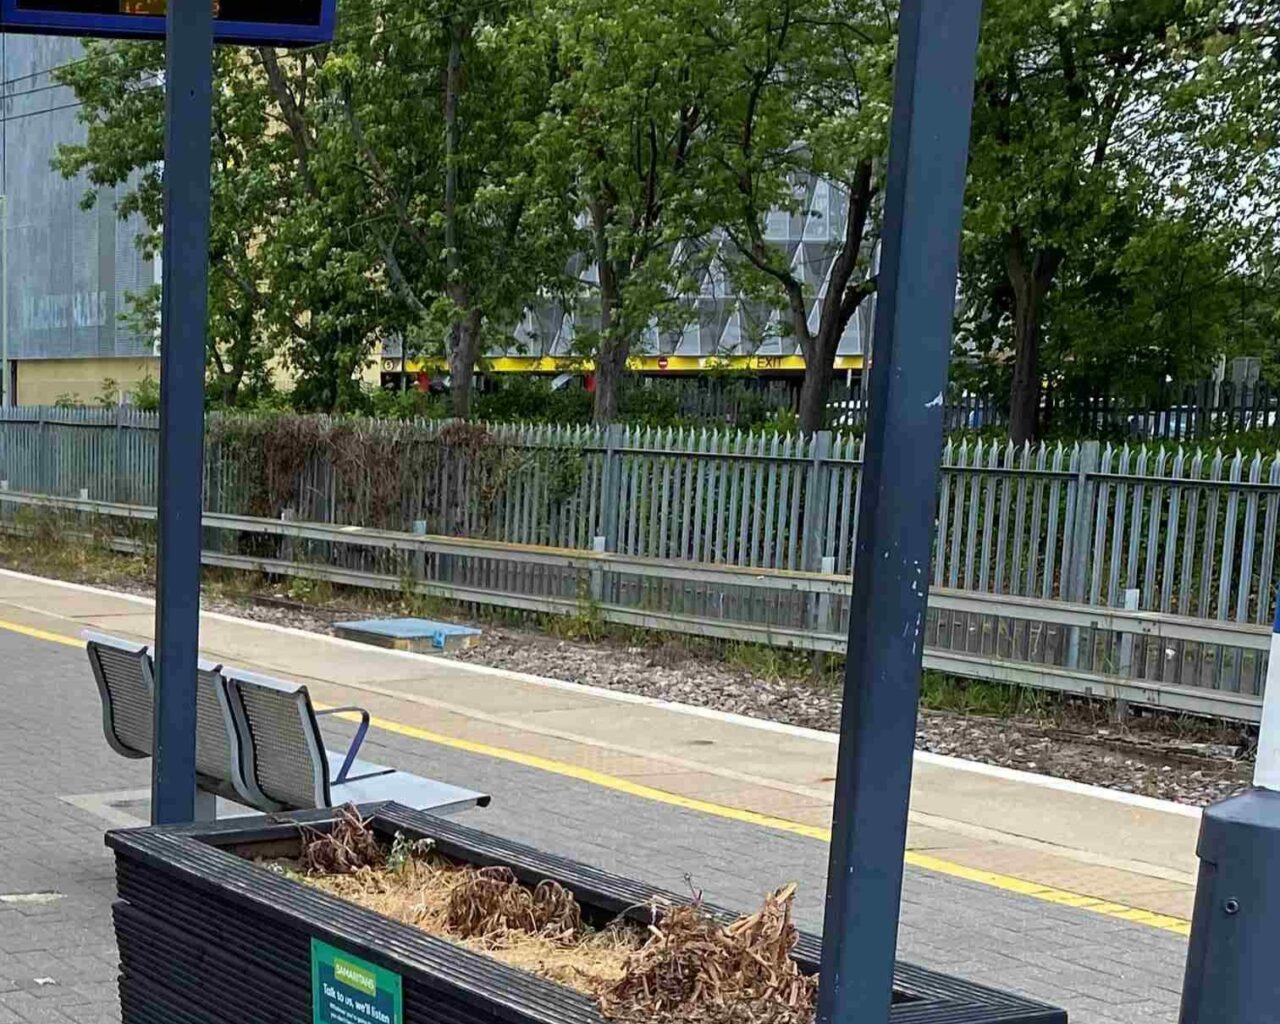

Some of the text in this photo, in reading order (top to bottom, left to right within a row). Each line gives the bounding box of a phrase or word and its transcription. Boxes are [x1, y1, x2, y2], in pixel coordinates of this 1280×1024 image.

[757, 355, 781, 368] EXIT
[323, 983, 336, 999] Talk
[337, 990, 344, 1003] to
[345, 996, 354, 1010] us,
[355, 1001, 371, 1015] we'll
[371, 1005, 390, 1024] listen
